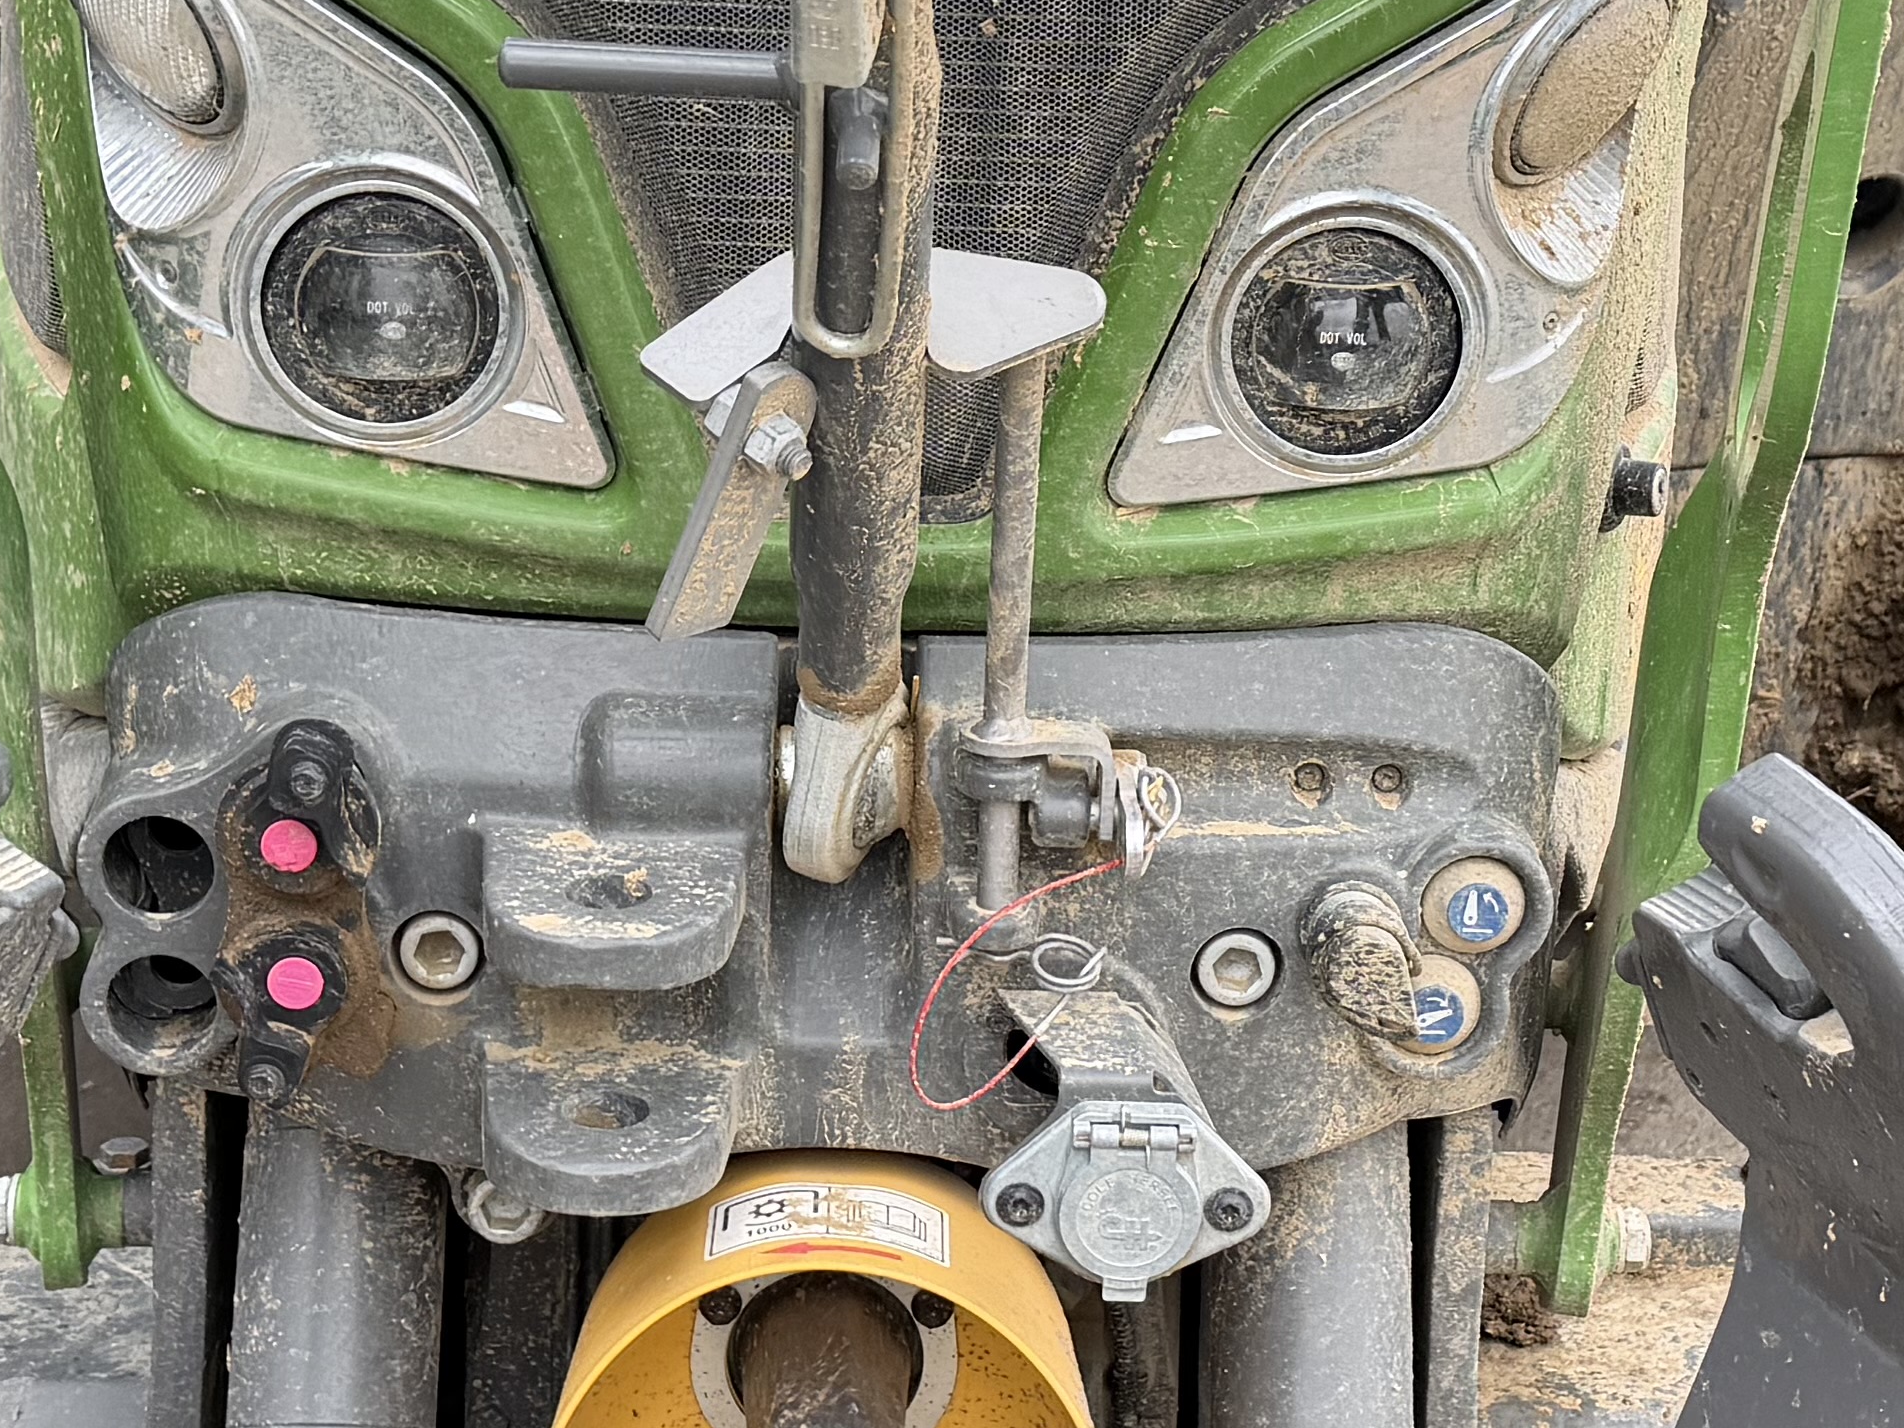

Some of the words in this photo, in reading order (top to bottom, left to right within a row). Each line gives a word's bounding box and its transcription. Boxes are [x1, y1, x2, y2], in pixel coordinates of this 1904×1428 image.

[366, 301, 389, 314] DOT
[1320, 331, 1340, 345] DOT
[1347, 331, 1367, 346] VOL
[747, 1223, 792, 1237] 1000
